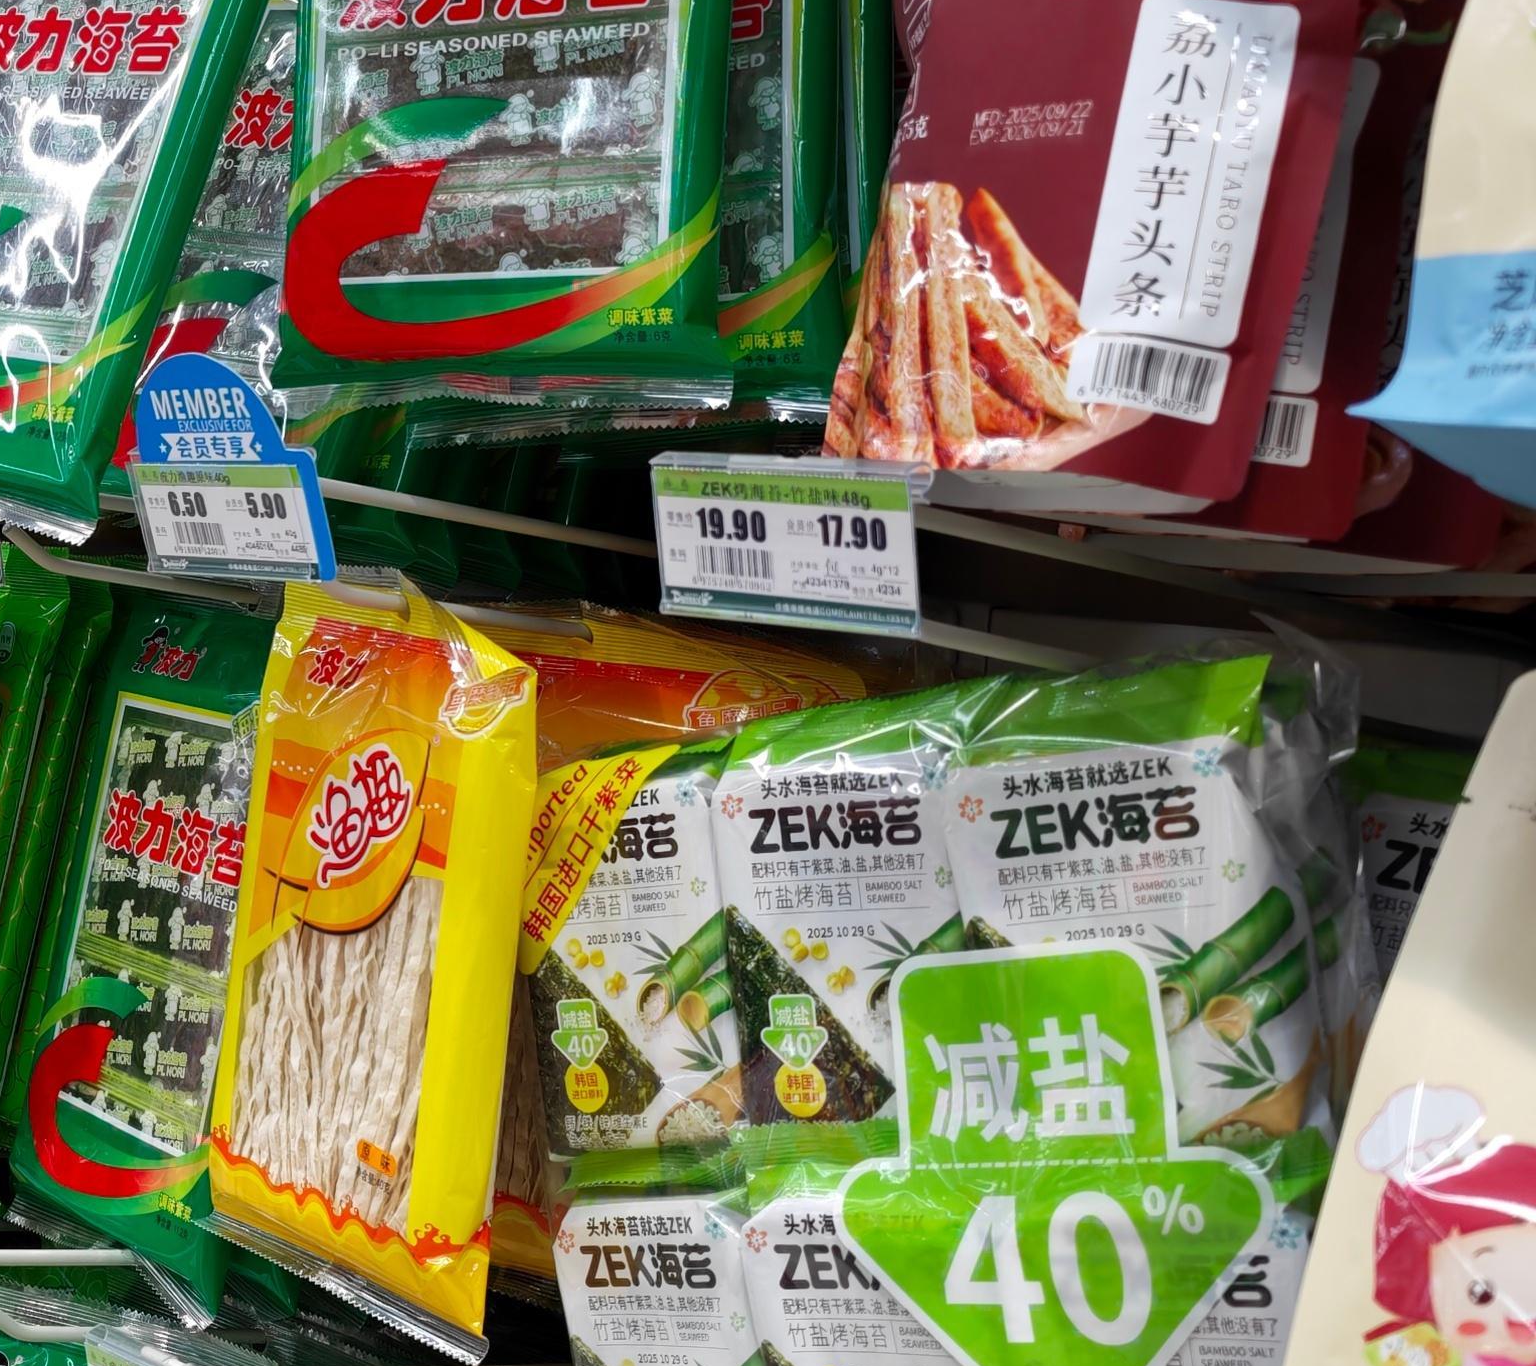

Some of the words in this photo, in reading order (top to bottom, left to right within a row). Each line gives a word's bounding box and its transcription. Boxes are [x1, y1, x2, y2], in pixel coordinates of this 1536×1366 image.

[337, 38, 402, 63] PO-LI
[403, 32, 528, 59] SEASONED
[534, 20, 652, 50] SEAWEED
[1111, 10, 1225, 318] 荔小芋芋头条
[1216, 161, 1250, 232] TARO
[1200, 239, 1234, 320] STRIP
[609, 307, 675, 328] 调味紫菜
[738, 330, 805, 352] 调味紫菜
[150, 387, 251, 421] MEMBER
[178, 420, 231, 433] EXCLUSIVE
[233, 420, 253, 432] FOR
[175, 435, 247, 460] 会员专享
[167, 491, 208, 518] 6.50
[245, 492, 288, 520] 5.90
[696, 507, 768, 544] 19.90
[817, 514, 888, 551] 17.90
[153, 648, 200, 682] 波力
[1002, 756, 1174, 797] 头水海苔就选ZEK
[101, 787, 248, 891] 波力海苔
[748, 797, 923, 855] ZEK海苔
[991, 787, 1201, 860] ZEK海苔
[520, 756, 643, 945] 韩国进口干紫菜
[181, 884, 237, 914] SEAWEED
[753, 881, 854, 914] 竹盐烤海苔
[867, 892, 906, 904] SEAWEED
[1002, 883, 1119, 920] 竹盐烤海苔
[807, 927, 832, 939] 2025
[1066, 928, 1097, 942] 2025
[562, 1006, 593, 1031] 减盐
[573, 1071, 600, 1089] 韩国
[782, 1072, 816, 1091] 韩国
[922, 1013, 1136, 1143] 减盐
[357, 1142, 395, 1175] 原味
[586, 1215, 694, 1236] 头水海苔就选ZEK
[580, 1243, 718, 1291] ZEK海苔
[942, 1183, 1206, 1349] 40%
[592, 1315, 670, 1345] 竹盐烤海苔
